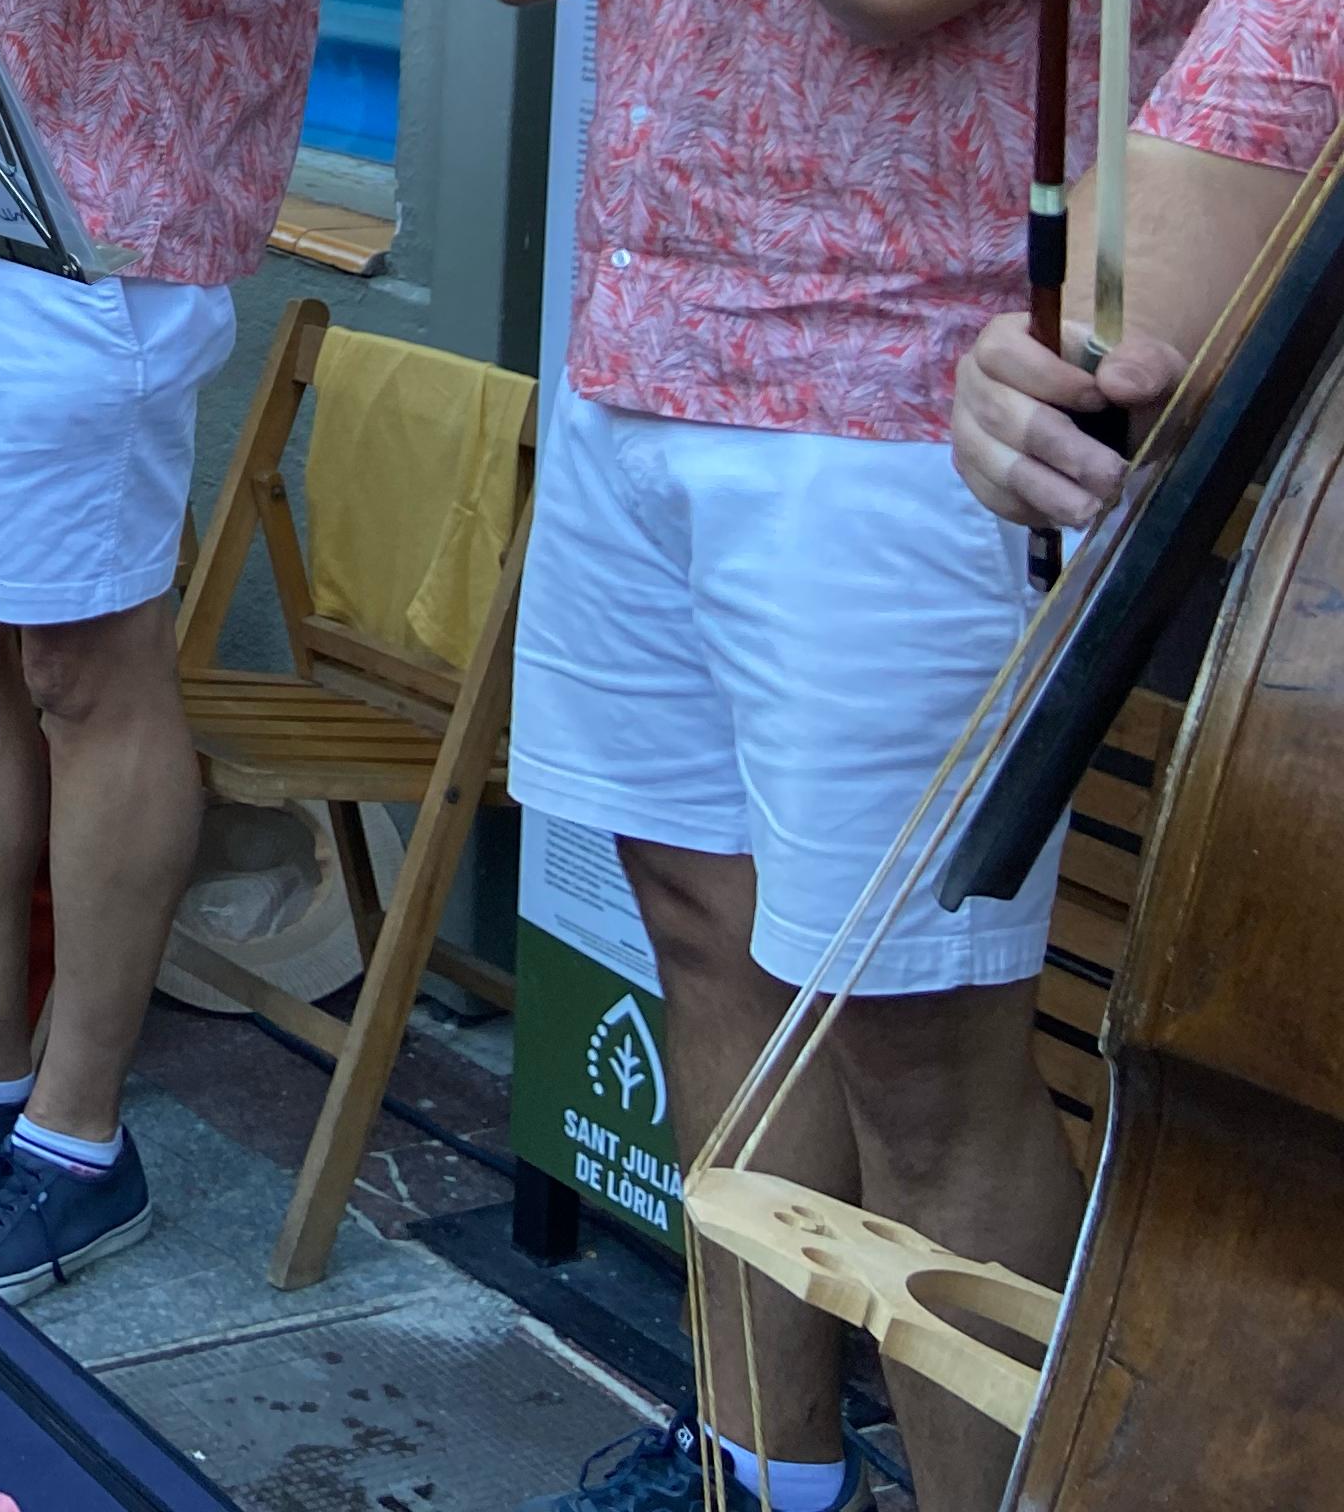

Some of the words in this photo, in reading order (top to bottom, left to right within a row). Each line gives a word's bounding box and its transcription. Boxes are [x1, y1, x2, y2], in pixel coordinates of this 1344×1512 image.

[563, 1108, 621, 1162] SANT
[621, 1144, 683, 1202] JULIÀ
[575, 1151, 603, 1192] DE
[606, 1169, 669, 1232] LÒRIA
